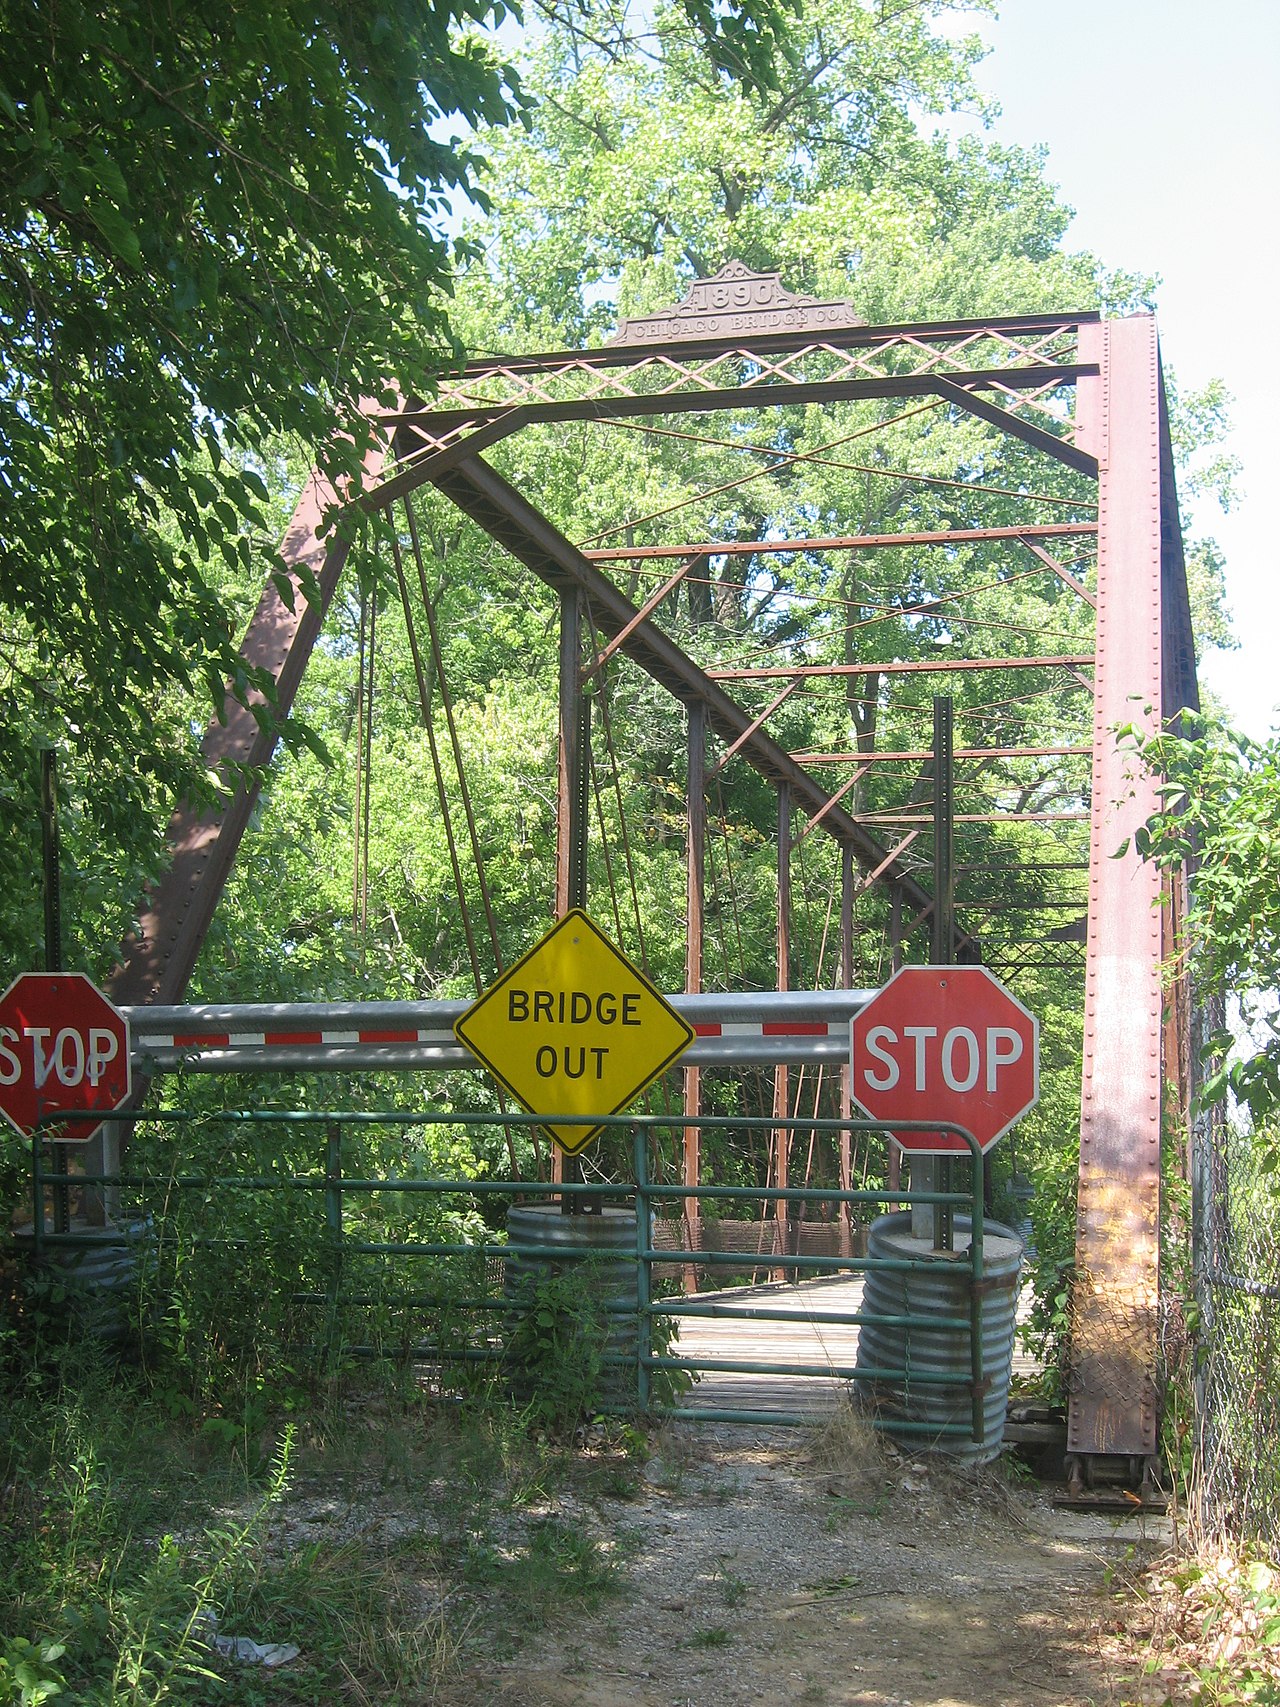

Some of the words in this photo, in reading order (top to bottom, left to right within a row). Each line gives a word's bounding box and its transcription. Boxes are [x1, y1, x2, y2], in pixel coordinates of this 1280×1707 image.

[696, 284, 774, 311] 1890
[634, 319, 720, 338] CHICAGO
[731, 309, 808, 331] BRIDGE
[815, 306, 843, 325] CO.
[507, 989, 642, 1026] BRIDGE
[0, 1026, 119, 1086] STOP
[535, 1045, 610, 1080] OUT
[863, 1025, 1024, 1093] STOP
